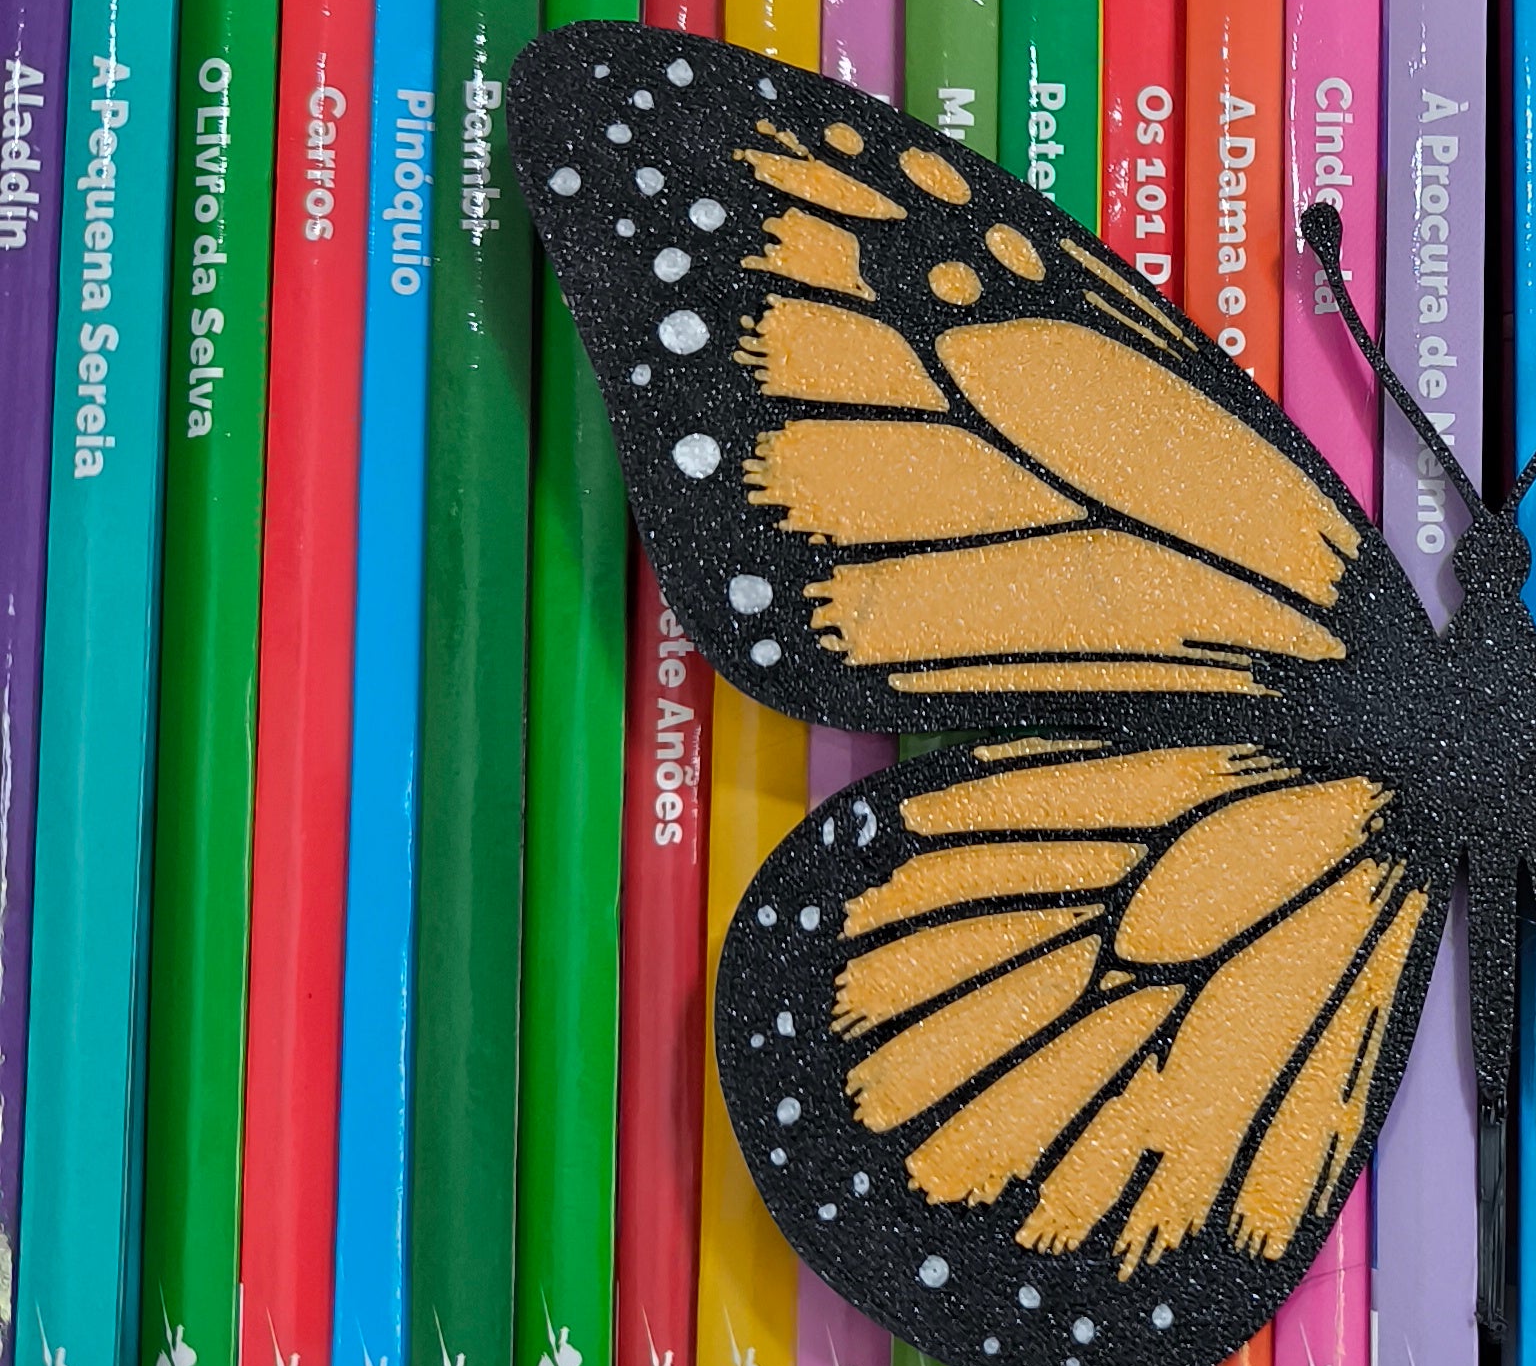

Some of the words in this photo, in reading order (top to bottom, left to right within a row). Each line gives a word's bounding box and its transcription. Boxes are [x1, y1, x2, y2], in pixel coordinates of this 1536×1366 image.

[93, 55, 130, 88] A
[199, 57, 232, 92] O
[1136, 85, 1173, 146] Os
[1219, 92, 1256, 122] A
[1421, 89, 1468, 122] À
[75, 98, 129, 311] Pequena
[193, 105, 231, 224] Livro
[304, 87, 347, 242] Carros
[383, 89, 436, 296] Pinóquio
[462, 80, 501, 231] Bambi
[1136, 158, 1167, 239] 101
[1218, 136, 1256, 274] Dama
[192, 236, 227, 296] da
[1418, 136, 1459, 325] Procura
[1218, 287, 1246, 315] e
[1218, 327, 1246, 356] o
[74, 322, 119, 479] Sereia
[188, 308, 225, 438] Selva
[1417, 336, 1457, 399] de
[655, 697, 695, 846] Anões
